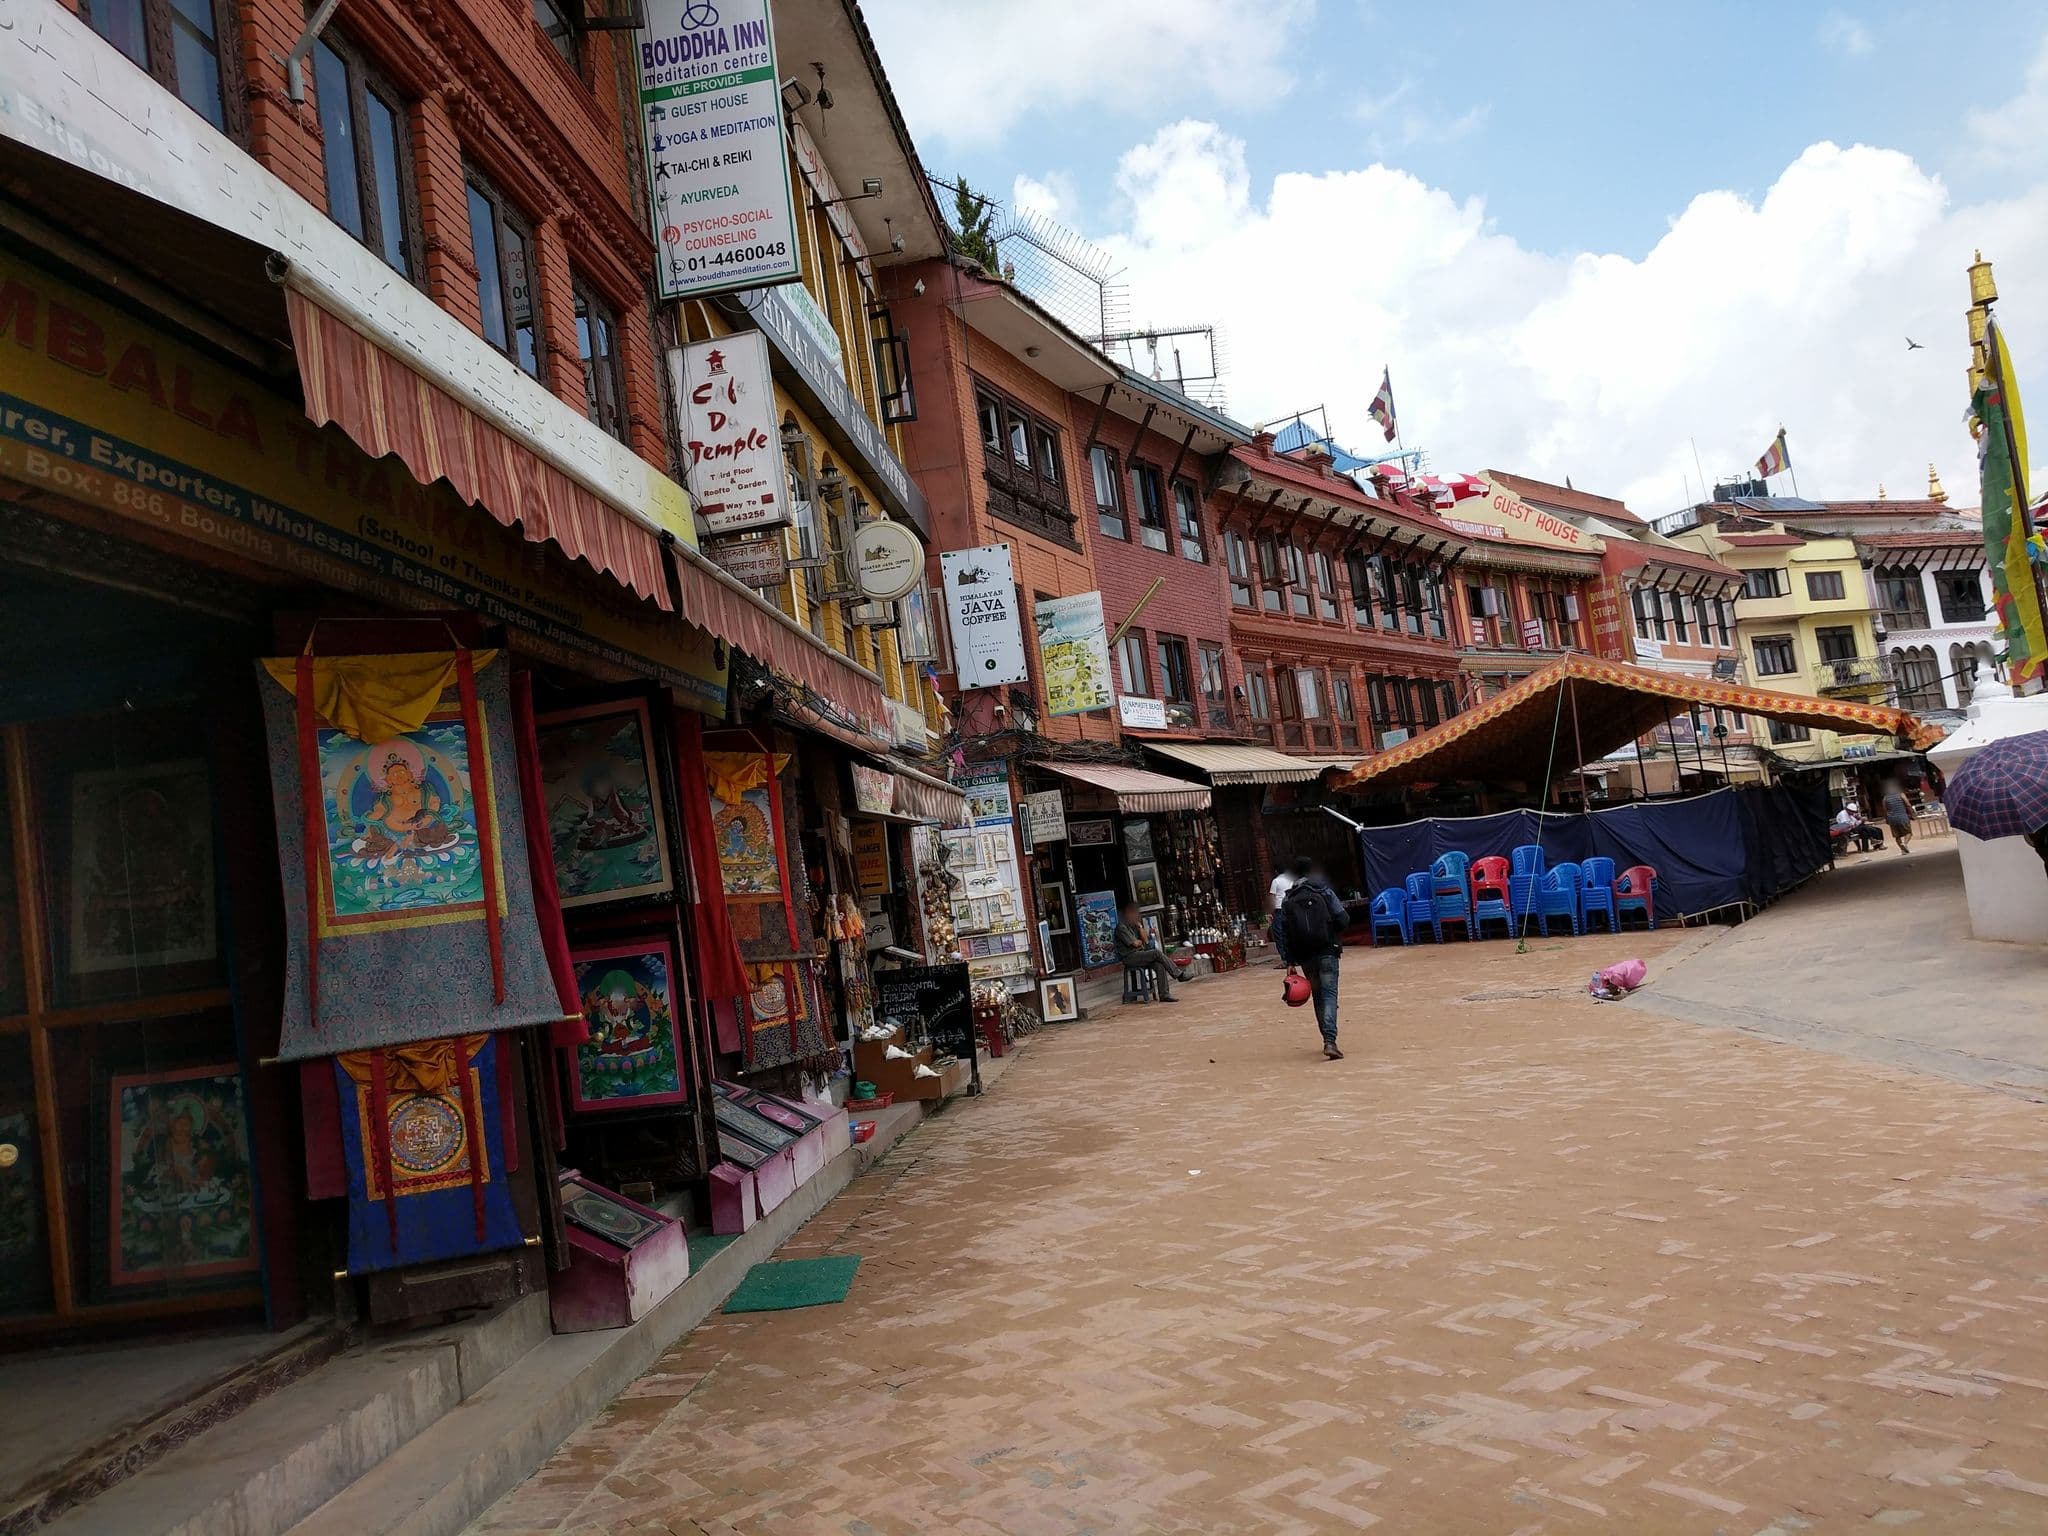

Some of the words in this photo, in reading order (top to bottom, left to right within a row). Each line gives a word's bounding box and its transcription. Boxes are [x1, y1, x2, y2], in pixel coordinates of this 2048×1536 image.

[642, 27, 730, 69] BOUDDHA
[734, 19, 767, 51] INN
[645, 62, 718, 86] meditation
[724, 51, 768, 71] centre
[671, 84, 690, 97] WE
[693, 73, 744, 92] PROVIDE
[671, 101, 707, 119] GUEST
[711, 93, 749, 111] HOUSE
[665, 130, 698, 147] YOGA
[700, 129, 708, 140] &
[710, 115, 776, 138] MEDITATION
[671, 158, 711, 176] TAI-CHI
[712, 156, 721, 167] &
[723, 149, 753, 165] REIKI
[680, 184, 740, 206] AYURVEDA
[683, 208, 774, 235] PSYCHO-SOCIAL
[685, 228, 757, 251] COUNSELING
[687, 241, 786, 271] 01-4460048
[675, 260, 790, 285] www.bouddhameditation.com
[687, 427, 768, 466] Temple
[851, 405, 876, 458] JAVA
[878, 443, 909, 503] COFFEE
[25, 449, 101, 497] Box:
[112, 480, 171, 522] 886,
[710, 471, 731, 481] Tird
[733, 467, 754, 476] Floor
[730, 477, 737, 485] &
[737, 480, 768, 491] Garden
[725, 502, 744, 510] Way
[725, 509, 766, 524] 2143256
[1493, 495, 1533, 523] GUEST
[1535, 512, 1580, 544] HOUSE
[90, 435, 241, 518] Exporter,
[251, 499, 386, 575] Wholesaler,
[391, 556, 461, 601] Retailer
[463, 591, 481, 609] of
[487, 600, 542, 635] Tibetan,
[357, 513, 435, 556] (School
[439, 553, 457, 571] of
[462, 560, 520, 598] Thanka
[960, 589, 1004, 602] HIMALAYAN
[961, 598, 1006, 615] JAVA
[962, 611, 1007, 626] COFFEE
[1592, 604, 1618, 619] STUPA
